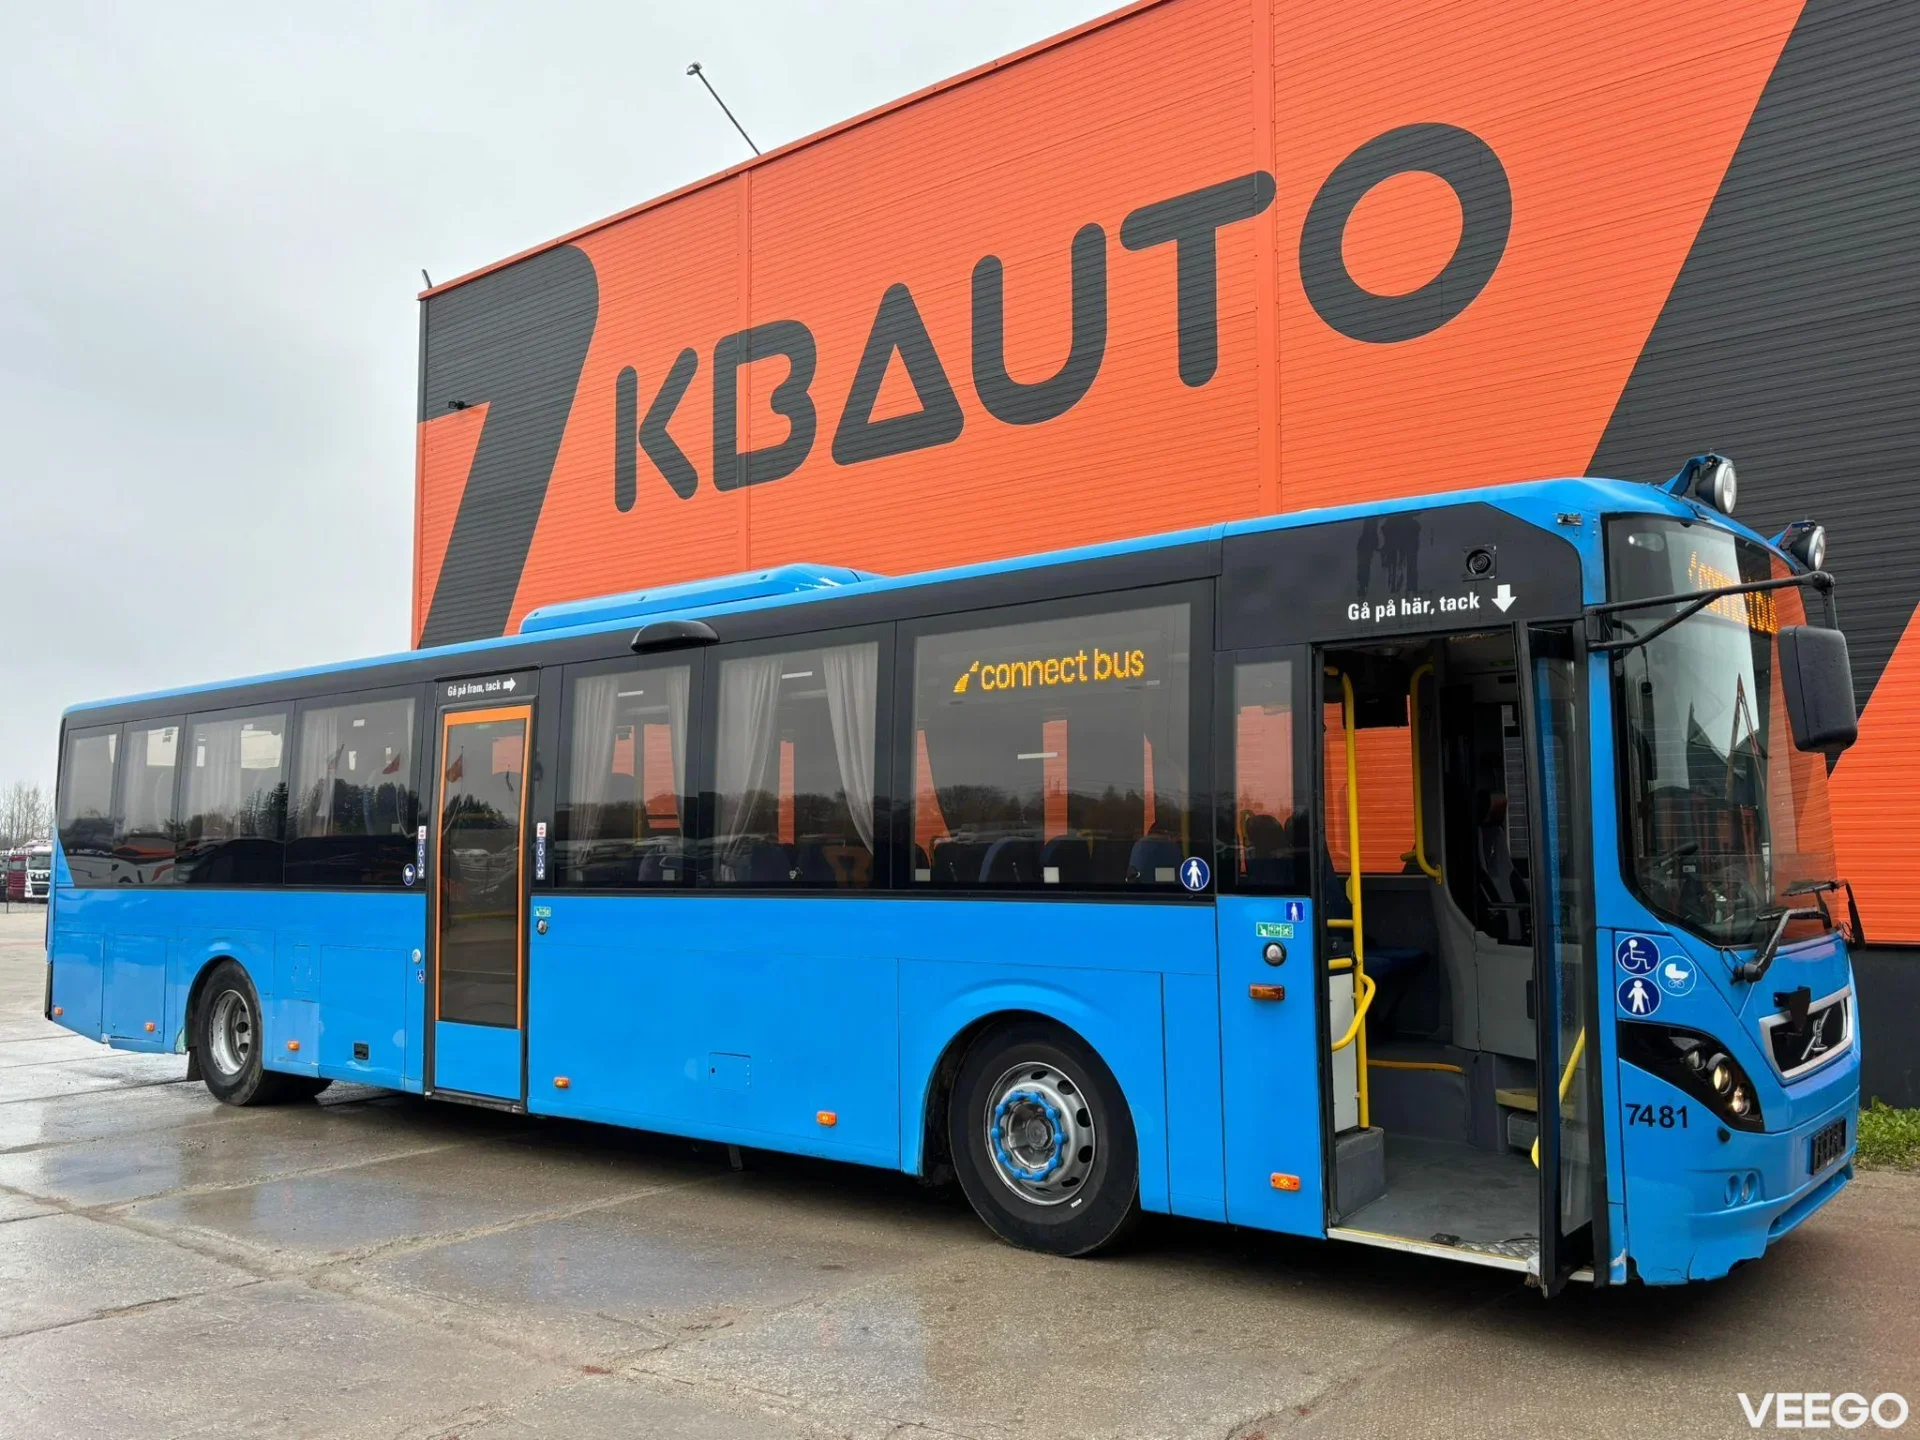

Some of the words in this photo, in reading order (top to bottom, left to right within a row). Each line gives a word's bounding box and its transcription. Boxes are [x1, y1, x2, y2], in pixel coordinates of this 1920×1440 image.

[614, 121, 1513, 514] KBAUTO
[1348, 602, 1370, 620] Gå
[1375, 600, 1396, 622] på
[1401, 598, 1435, 615] här,
[1439, 592, 1480, 611] tack
[981, 649, 1088, 690] connect
[1094, 648, 1145, 680] bus
[467, 683, 484, 694] fram,
[486, 680, 501, 691] tack
[1625, 1103, 1688, 1129] 7481
